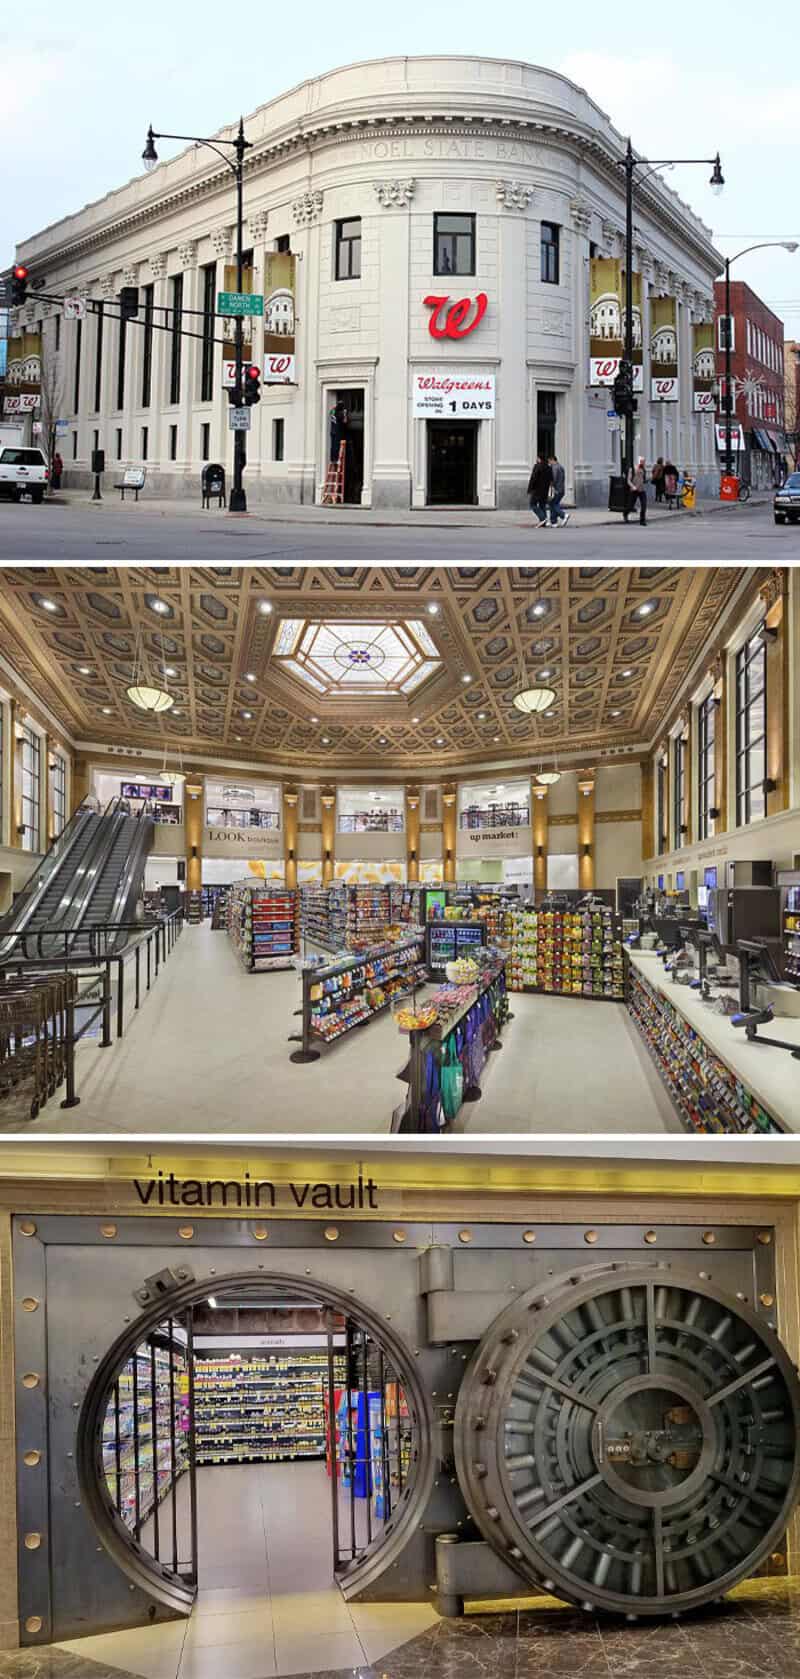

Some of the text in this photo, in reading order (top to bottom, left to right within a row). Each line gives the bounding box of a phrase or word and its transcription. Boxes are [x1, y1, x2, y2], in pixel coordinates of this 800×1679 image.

[360, 138, 546, 166] NOEL STATE BANK
[422, 292, 488, 340] W
[416, 376, 493, 395] Walgreens
[448, 400, 457, 413] 1
[462, 401, 492, 410] DAYS
[209, 831, 246, 842] LOOK
[470, 833, 481, 843] up
[132, 1170, 379, 1209] vitamin vault
